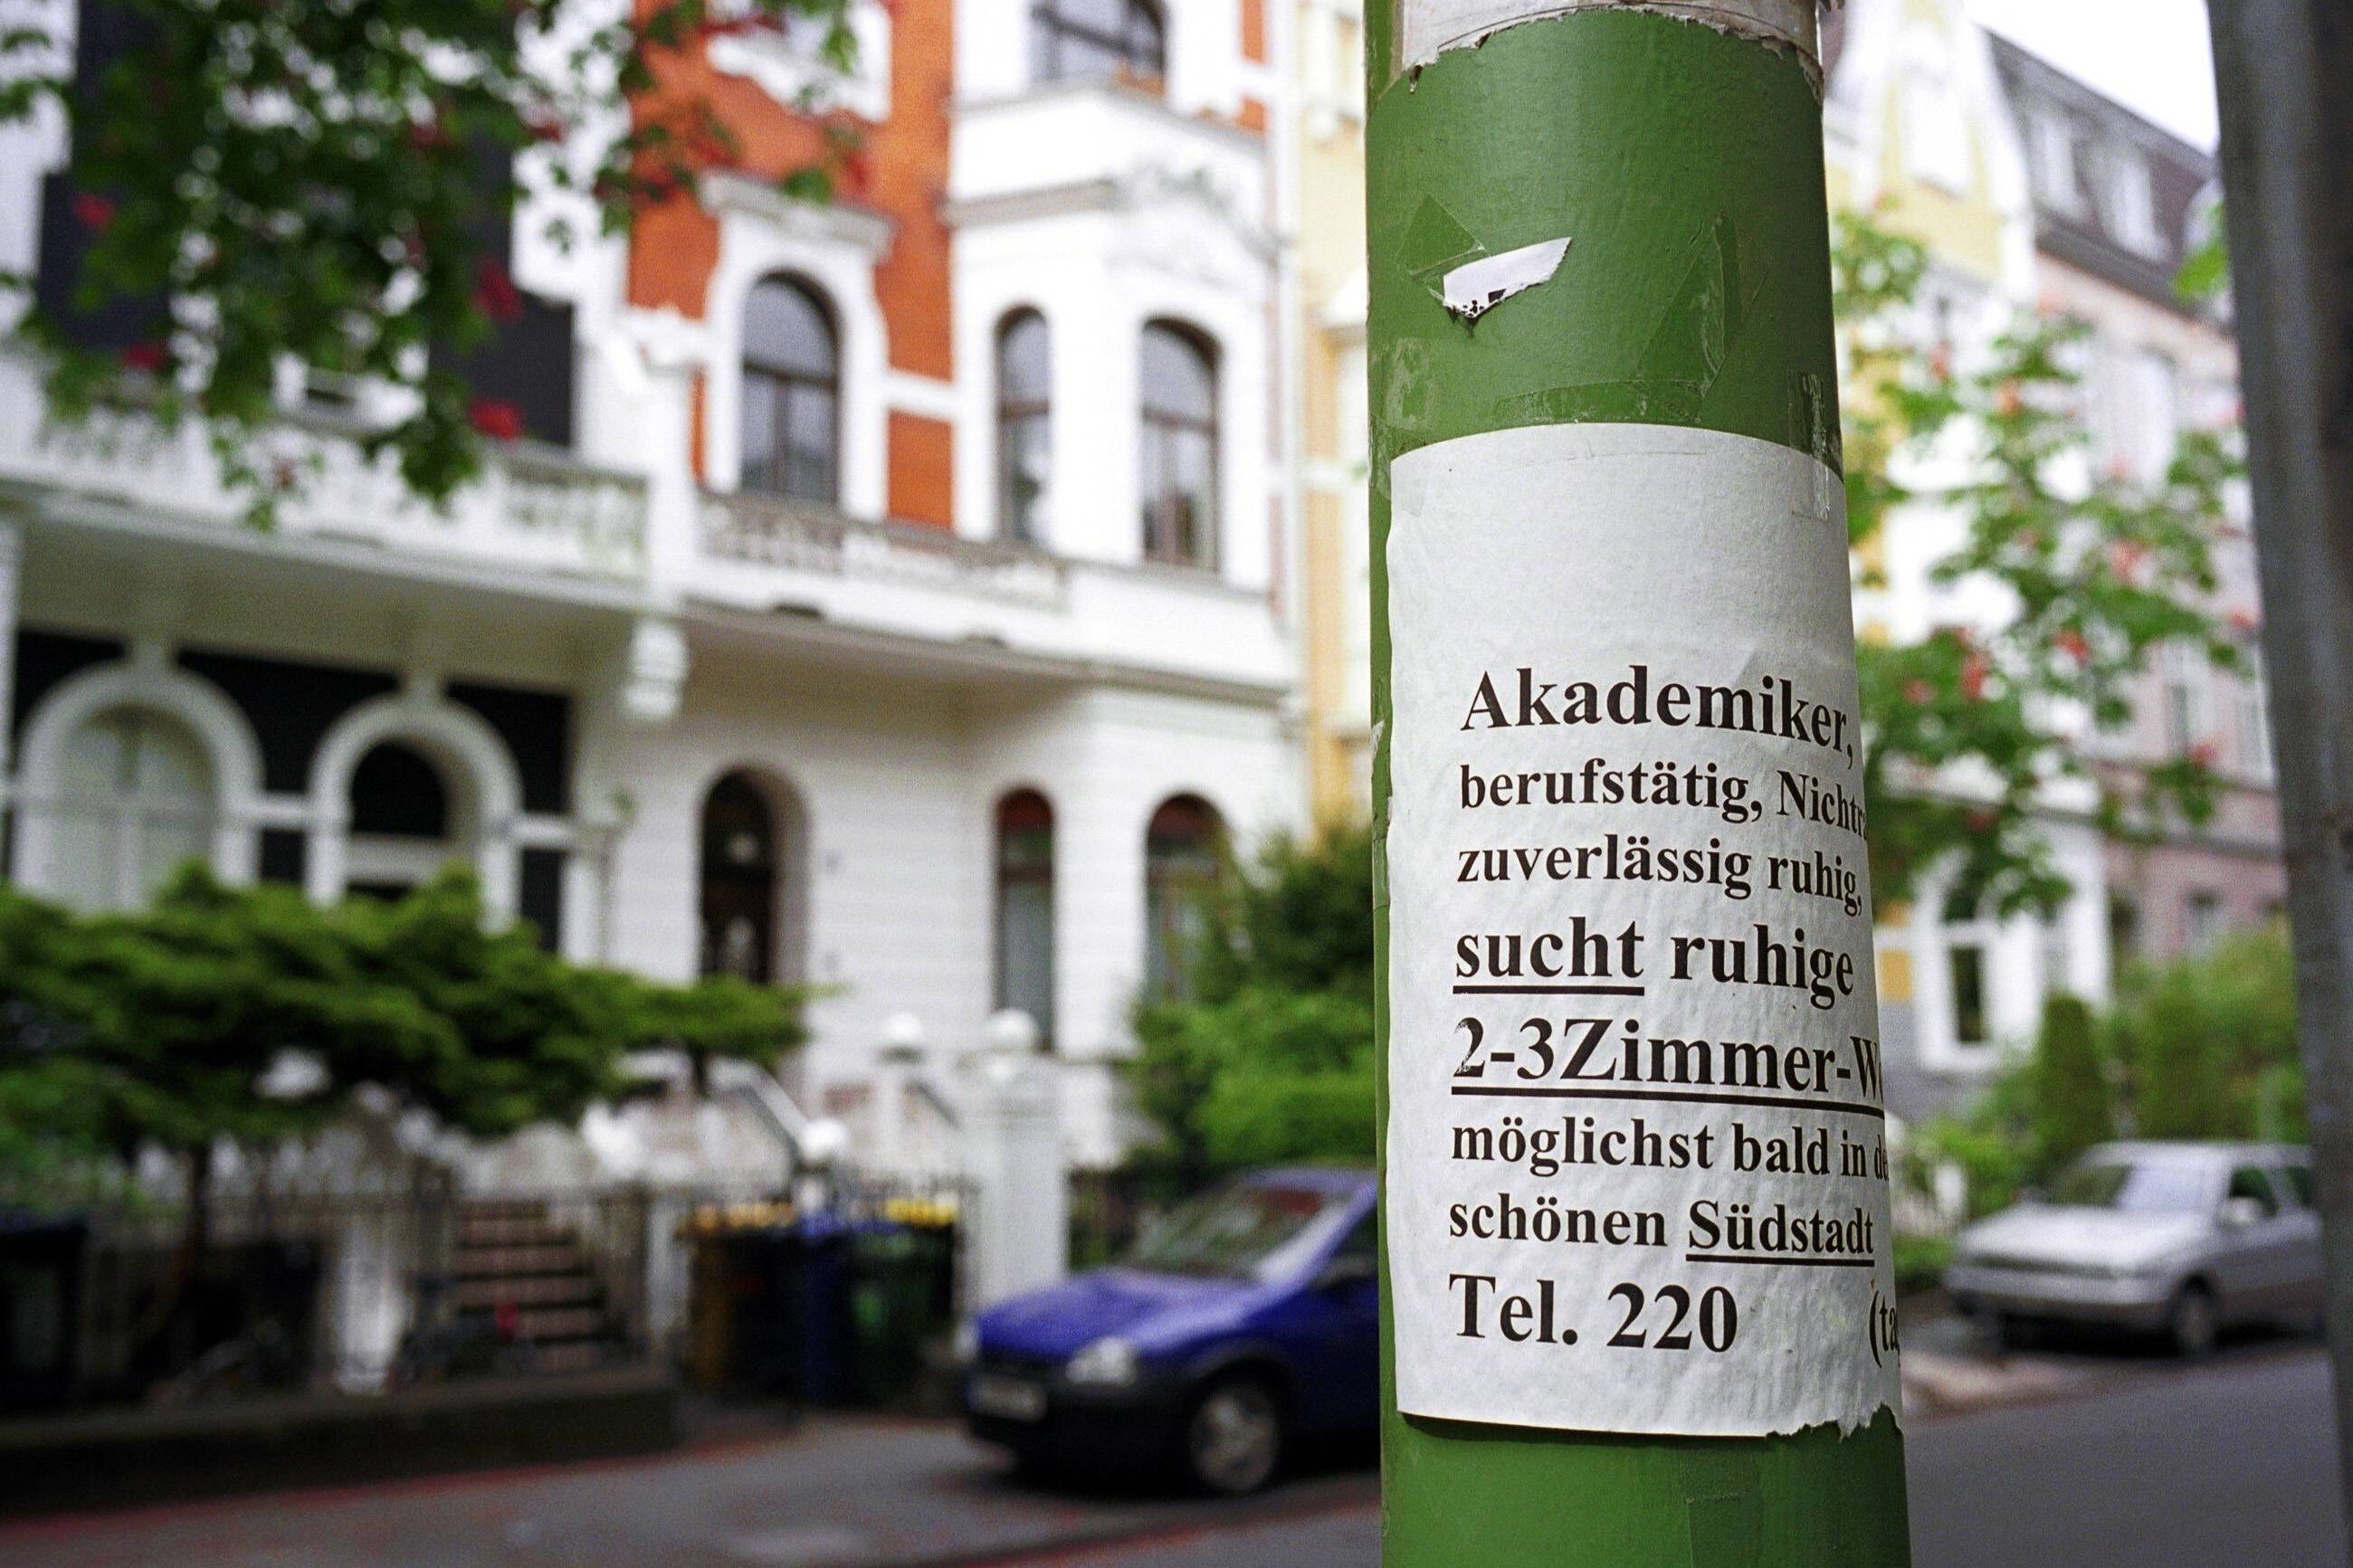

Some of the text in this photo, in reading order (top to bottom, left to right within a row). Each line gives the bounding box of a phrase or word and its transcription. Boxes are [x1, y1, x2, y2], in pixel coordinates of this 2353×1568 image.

[1461, 665, 1853, 769] Akademiker,
[1461, 758, 1763, 823] berufstätig,
[1457, 834, 1862, 917] zuverlässig ruhig,
[1456, 917, 1853, 1010] sucht ruhige
[1452, 1117, 1713, 1176] möglichst
[1732, 1123, 1830, 1175] bald
[1840, 1129, 1867, 1177] in
[1450, 1193, 1874, 1254] schönen Südstadt
[1449, 1274, 1900, 1369] Tel. 220 (ta
